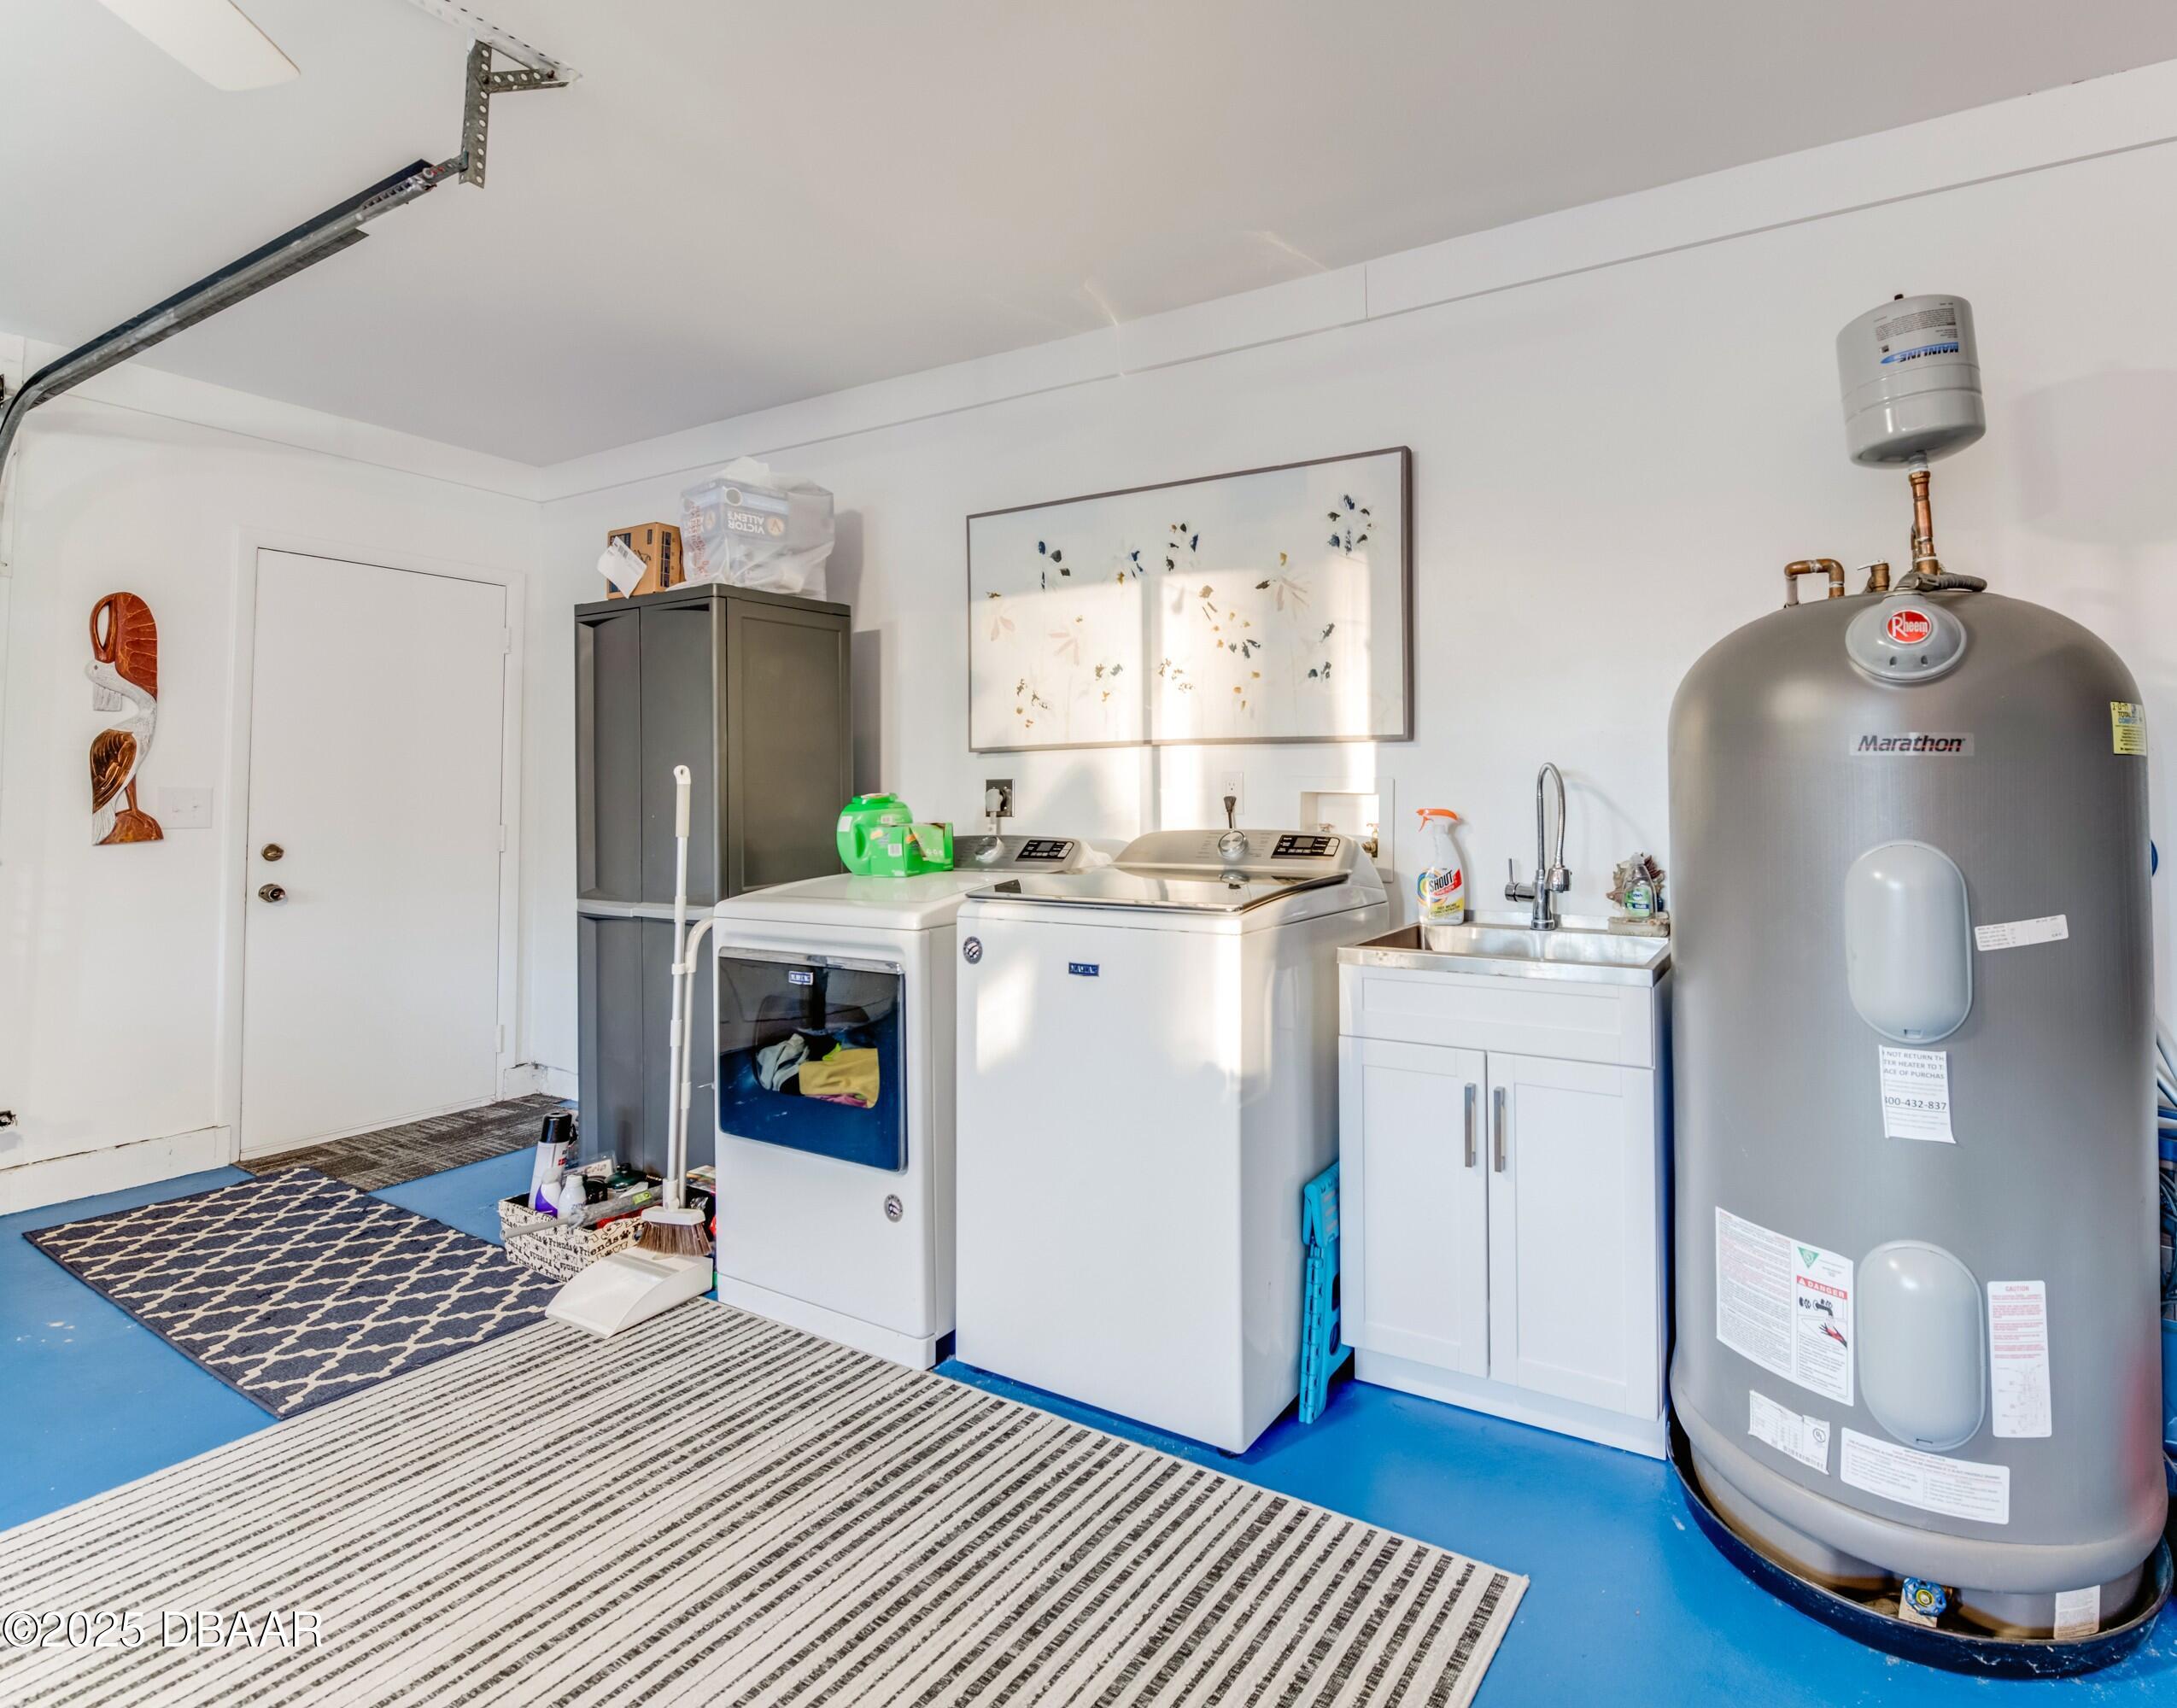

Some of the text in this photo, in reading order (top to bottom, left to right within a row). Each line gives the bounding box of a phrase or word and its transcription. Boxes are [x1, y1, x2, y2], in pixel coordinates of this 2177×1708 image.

[1898, 343, 1959, 363] MAINLINE
[728, 519, 765, 535] VICTOR
[1891, 612, 1928, 637] Rheem
[1858, 735, 1963, 752] Marathon
[1429, 869, 1453, 892] SHOUT
[1898, 1061, 1925, 1069] HEATER
[1807, 1281, 1846, 1298] DANGER
